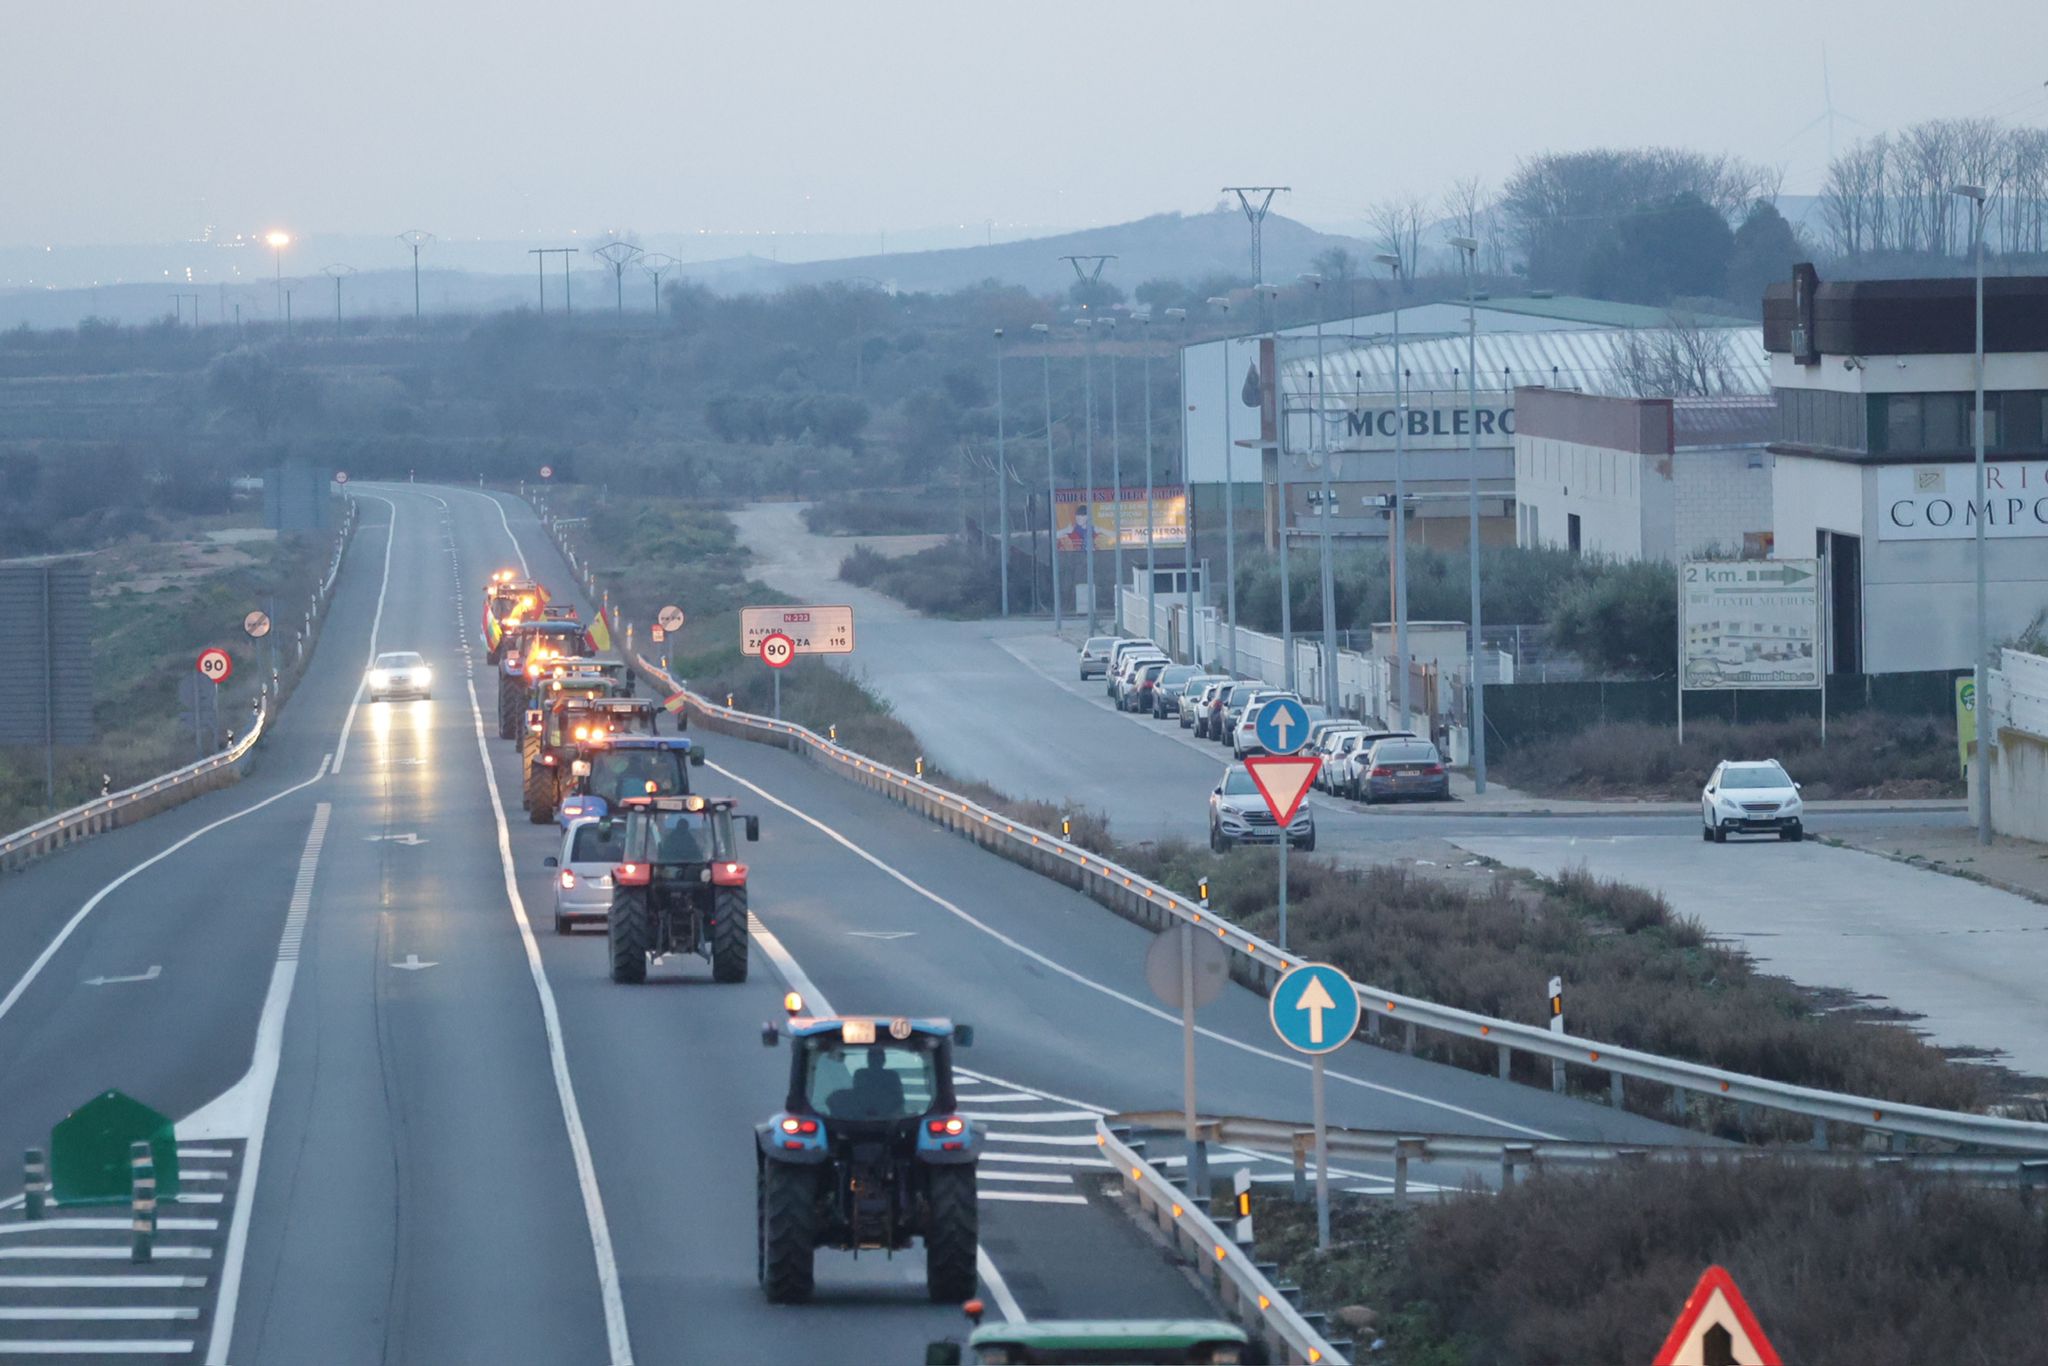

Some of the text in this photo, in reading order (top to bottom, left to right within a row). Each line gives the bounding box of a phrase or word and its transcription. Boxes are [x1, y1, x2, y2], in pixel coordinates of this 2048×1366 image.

[1986, 466, 2048, 490] RI
[1686, 567, 1742, 582] 2 km.
[830, 638, 846, 646] 116
[767, 645, 786, 656] 90
[204, 659, 223, 671] 90
